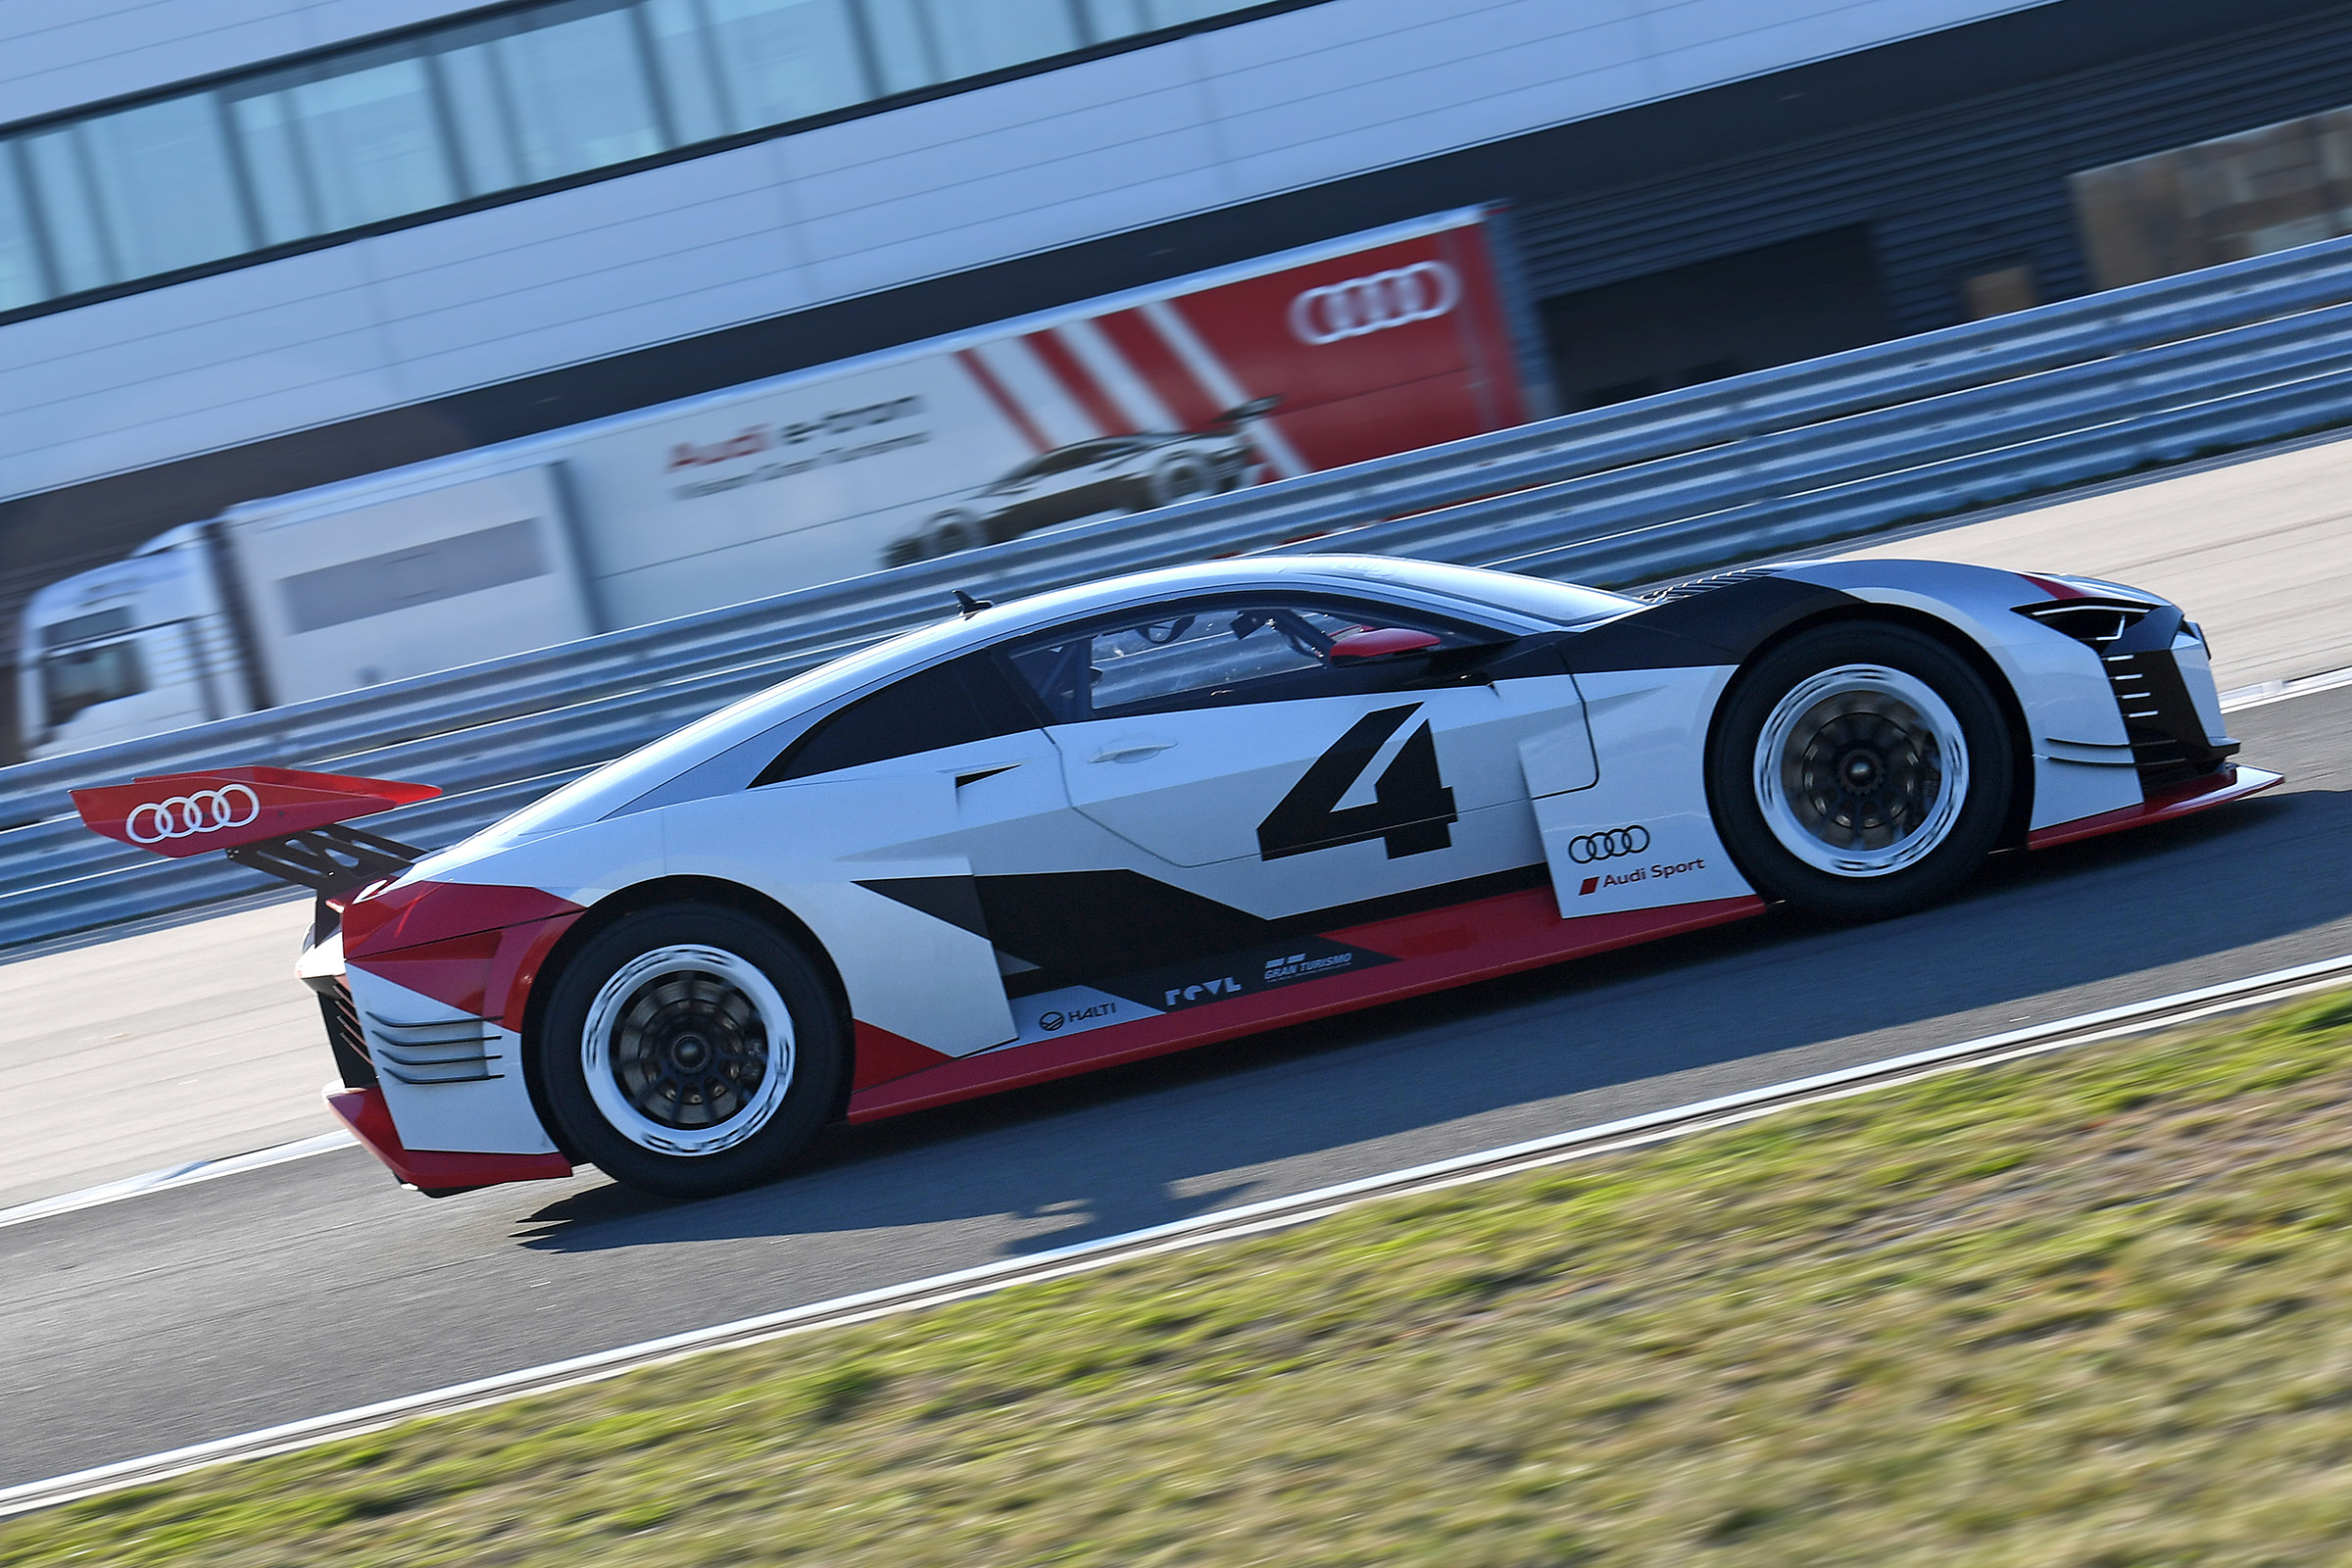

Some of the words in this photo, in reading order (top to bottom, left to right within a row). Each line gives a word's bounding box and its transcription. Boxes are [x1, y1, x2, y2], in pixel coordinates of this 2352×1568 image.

[1256, 701, 1458, 861] 4
[1603, 868, 1646, 888] Audi
[1651, 858, 1705, 879] Sport
[1264, 963, 1298, 980] GRAN
[1299, 953, 1352, 972] TURISMO
[1068, 1002, 1116, 1022] HALTI
